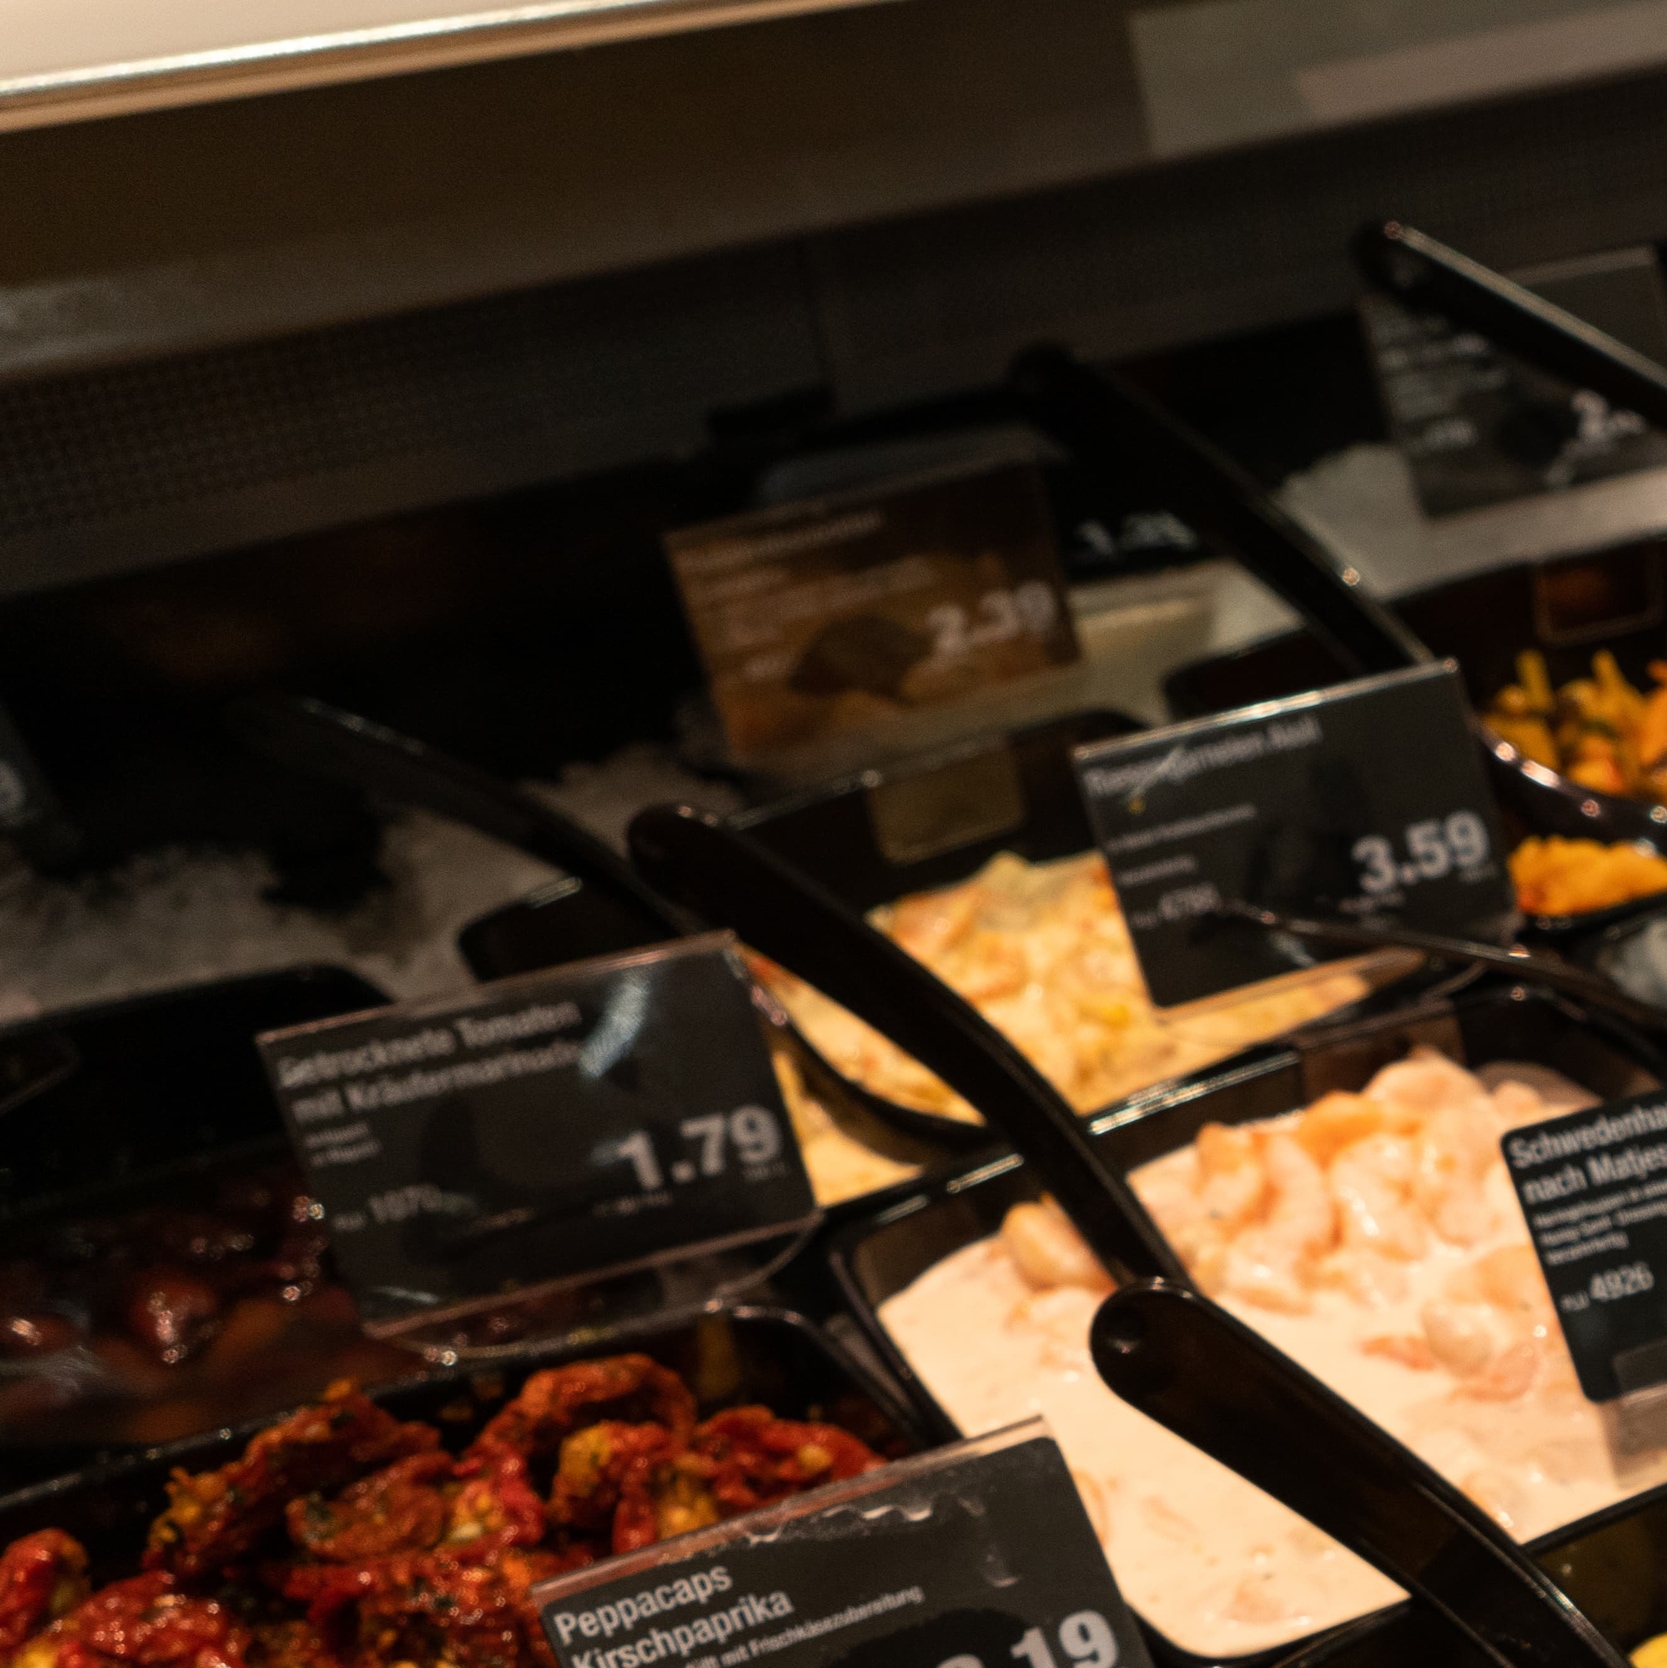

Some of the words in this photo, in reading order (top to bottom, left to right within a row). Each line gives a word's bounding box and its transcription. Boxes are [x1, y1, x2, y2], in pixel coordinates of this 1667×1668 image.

[1355, 812, 1486, 891] 3.59
[617, 1107, 775, 1187] 1.79
[1523, 1164, 1588, 1203] nach
[1590, 1266, 1651, 1299] 4926
[553, 1566, 731, 1644] Peppacaps
[720, 1644, 750, 1666] mit
[747, 1586, 923, 1656] Frischkäsezubereitung
